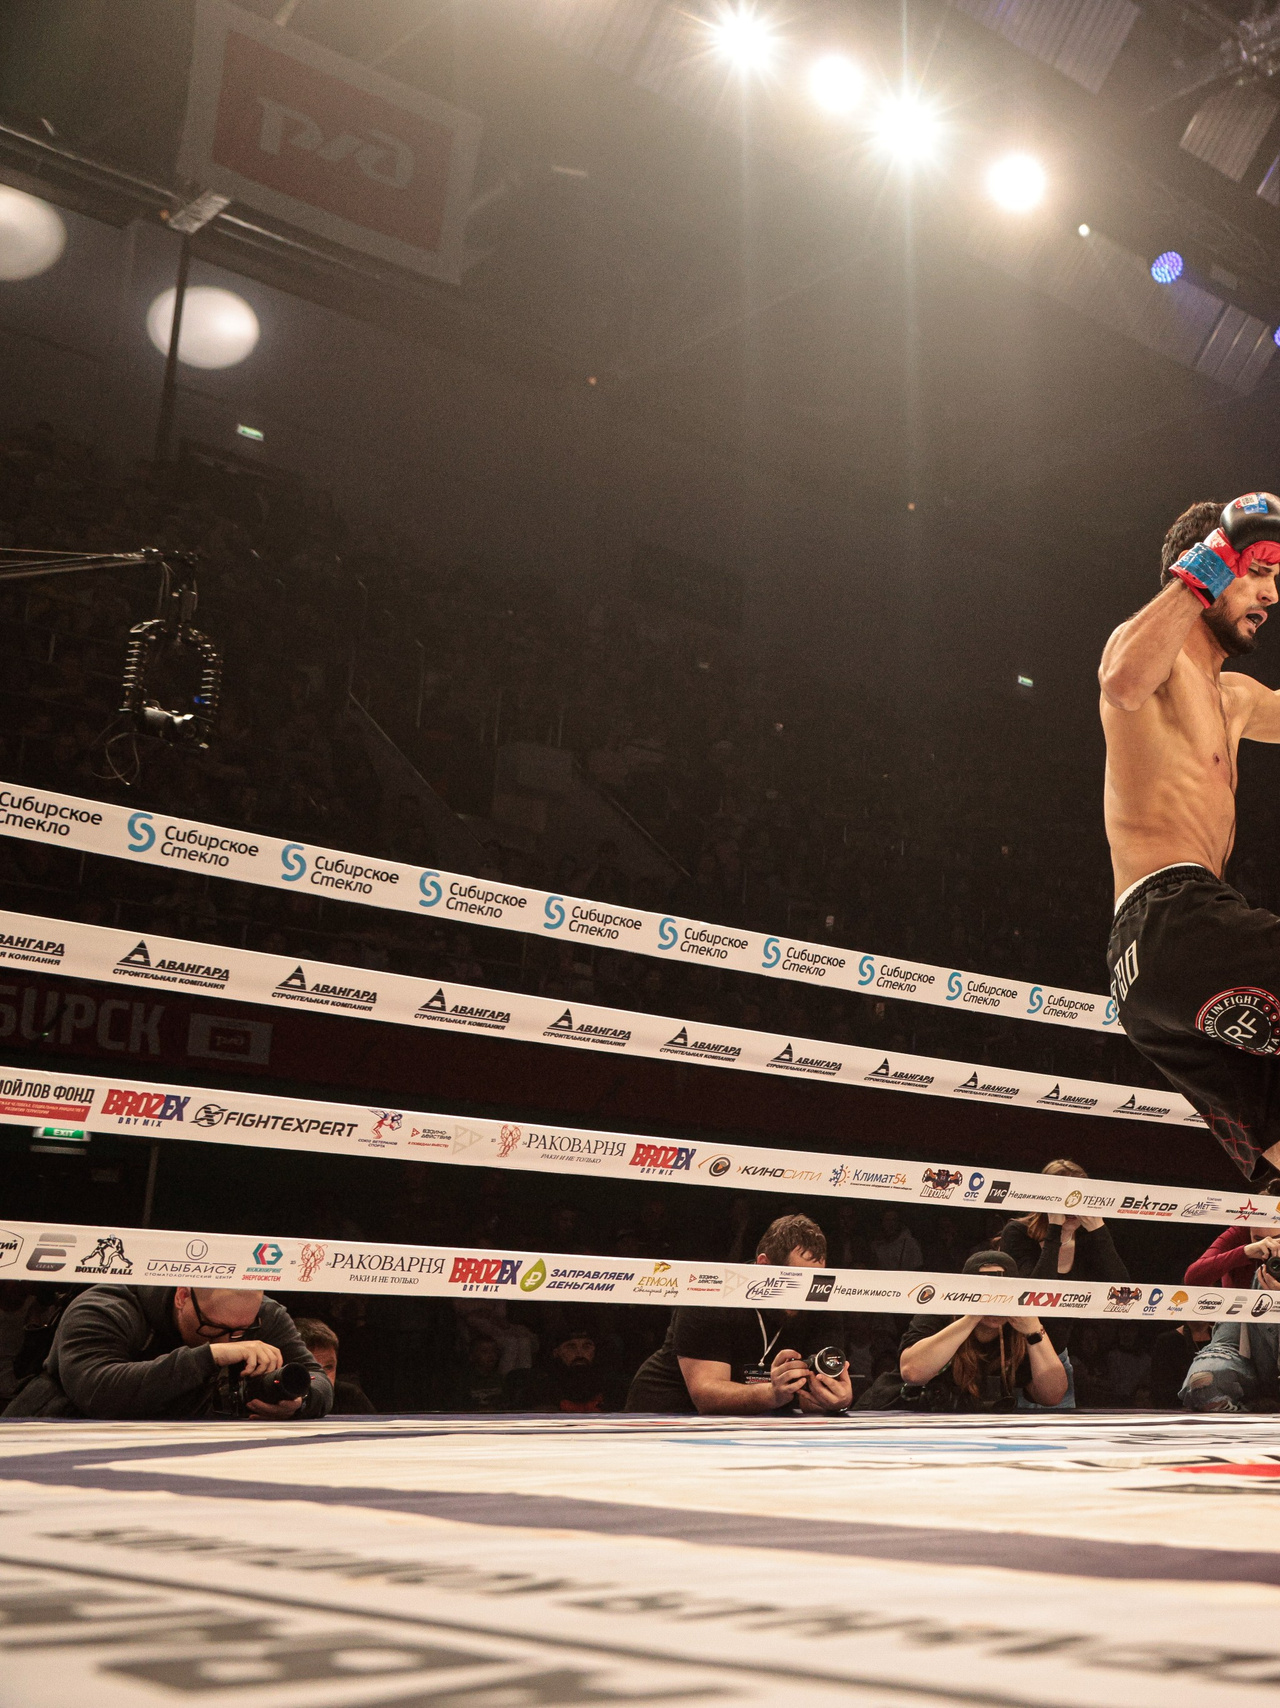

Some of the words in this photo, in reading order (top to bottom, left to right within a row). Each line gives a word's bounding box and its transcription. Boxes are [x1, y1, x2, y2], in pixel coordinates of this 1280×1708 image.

[0, 791, 102, 825] Сибирское
[165, 826, 259, 857] Сибирское
[160, 841, 229, 867] Стекло
[315, 856, 399, 884] Сибирское
[310, 871, 372, 895] Стекло
[450, 882, 527, 908] Сибирское
[446, 897, 502, 918] Стекло
[572, 906, 642, 930] Сибирское
[569, 920, 619, 940] Стекло
[684, 928, 748, 950] Сибирское
[0, 934, 65, 956] ВАНГАРД
[680, 941, 728, 960] Стекло
[8, 953, 61, 966] КОМПАНИЯ
[782, 958, 825, 978] Стекло
[786, 947, 846, 969] Сибирское
[113, 968, 177, 984] СТРОИТЕЛЬНАЯ
[179, 976, 225, 990] КОМПАНИЯ
[156, 959, 230, 981] АВАНГАРД
[880, 964, 935, 985] Сибирское
[311, 983, 377, 1003] АВАНГАРД
[876, 977, 916, 993] Стекло
[967, 980, 1018, 999] Сибирское
[272, 992, 329, 1006] СТРОИТЕЛЬНАЯ
[330, 1000, 373, 1012] КОМПАНИЯ
[963, 992, 1000, 1007] Стекло
[1047, 995, 1095, 1012] Сибирское
[1211, 1003, 1224, 1015] IN
[1224, 995, 1260, 1006] FIGHT
[414, 1013, 467, 1027] СТРОИТЕЛЬНАЯ
[468, 1020, 506, 1031] КОМПАНИЯ
[450, 1004, 510, 1023] АВАНГАРД
[1043, 1007, 1078, 1020] Стекло
[576, 1023, 631, 1040] АВАНГАРД
[1224, 1010, 1257, 1043] RF
[691, 1040, 742, 1056] АВАНГАРД
[795, 1056, 842, 1072] АВАНГАРД
[891, 1072, 934, 1084] АВАНГАРД
[0, 1079, 51, 1098] ОЙЛОВ
[54, 1085, 95, 1104] ФОНД
[980, 1084, 1019, 1095] АВАНГАРД
[100, 1089, 191, 1121] BROZEX
[1061, 1095, 1098, 1106] АВАНГАРД
[1137, 1105, 1170, 1114] АВАНГАРД
[224, 1112, 358, 1138] FIGHTEXPERT
[527, 1134, 626, 1158] РАКОВАРНЯ
[629, 1143, 697, 1171] BROZEX
[989, 1188, 1008, 1198] ГИС
[1009, 1190, 1062, 1202] Недвижимость
[75, 1266, 107, 1274] BOXING
[330, 1252, 446, 1274] РАКОВАРНЯ
[449, 1257, 523, 1285] BROZEX
[551, 1268, 635, 1281] ЗАПРАВЛЯЕМ
[546, 1280, 615, 1292] ДЕНЬГАМИ
[810, 1284, 832, 1294] ГИС
[834, 1285, 901, 1297] Недвижимость
[1062, 1292, 1091, 1302] СТРОЙ
